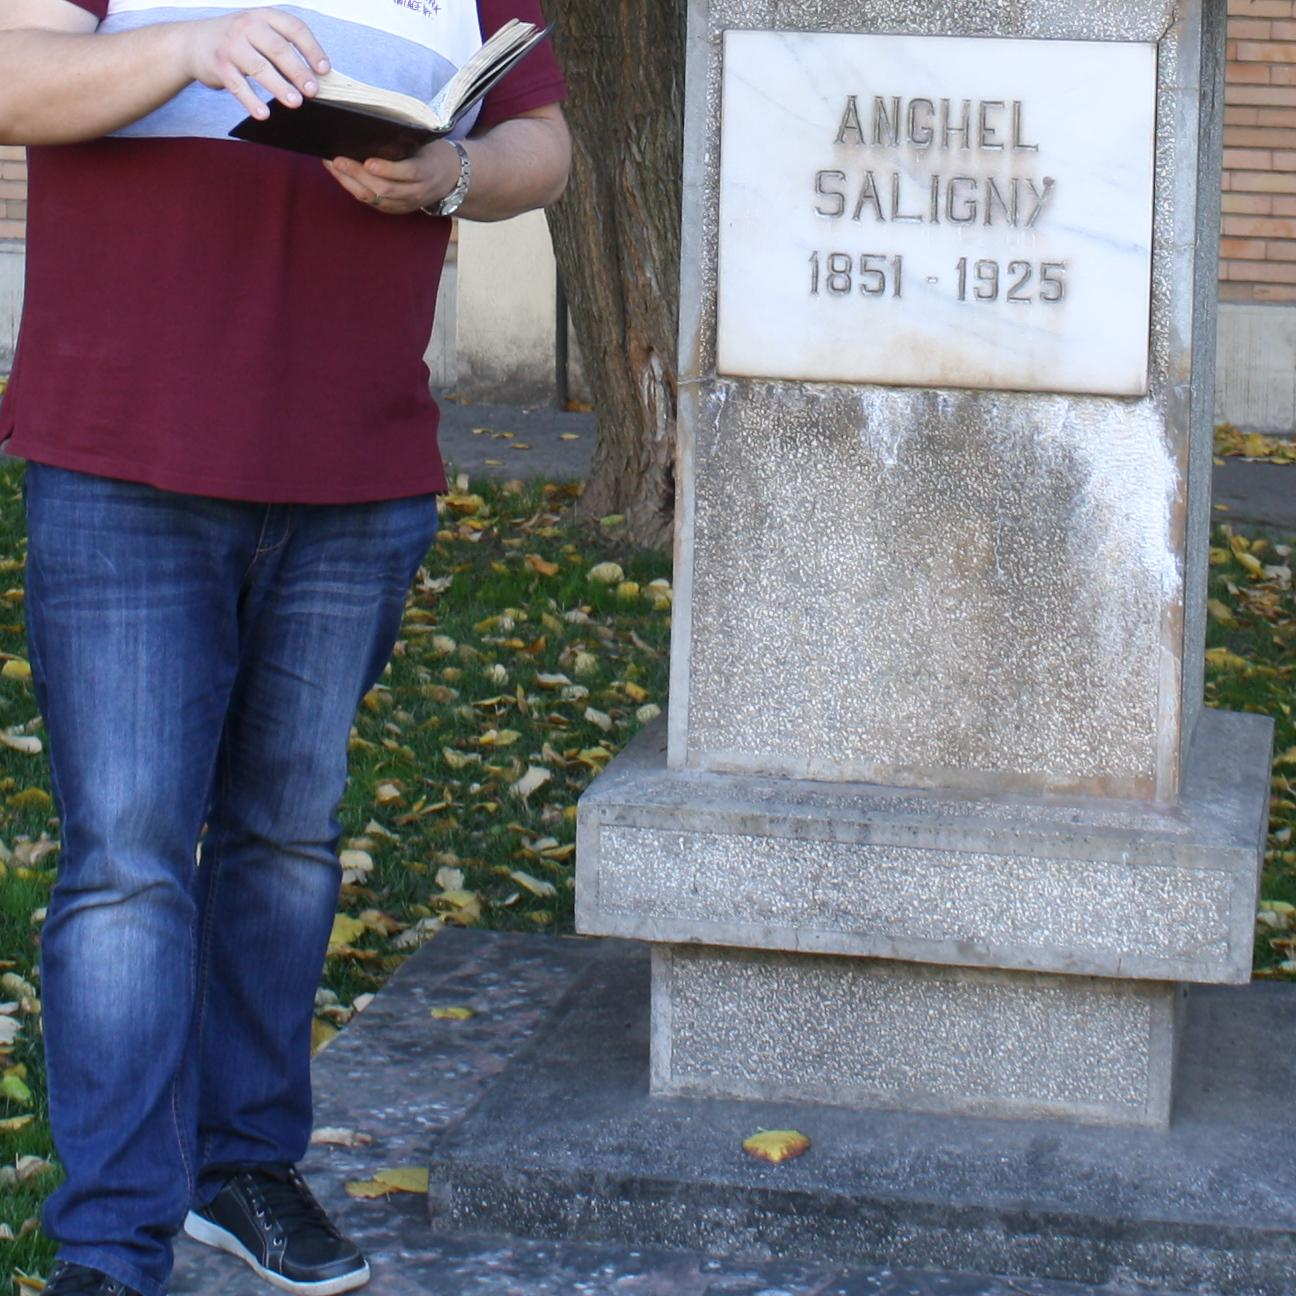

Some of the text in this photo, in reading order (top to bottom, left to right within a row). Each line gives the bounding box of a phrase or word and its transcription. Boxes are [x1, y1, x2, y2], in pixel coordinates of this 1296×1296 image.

[833, 95, 1039, 152] ANGHEL
[813, 169, 1056, 229] SALIGNY
[808, 250, 904, 299] 1851
[956, 256, 1067, 304] 1925
